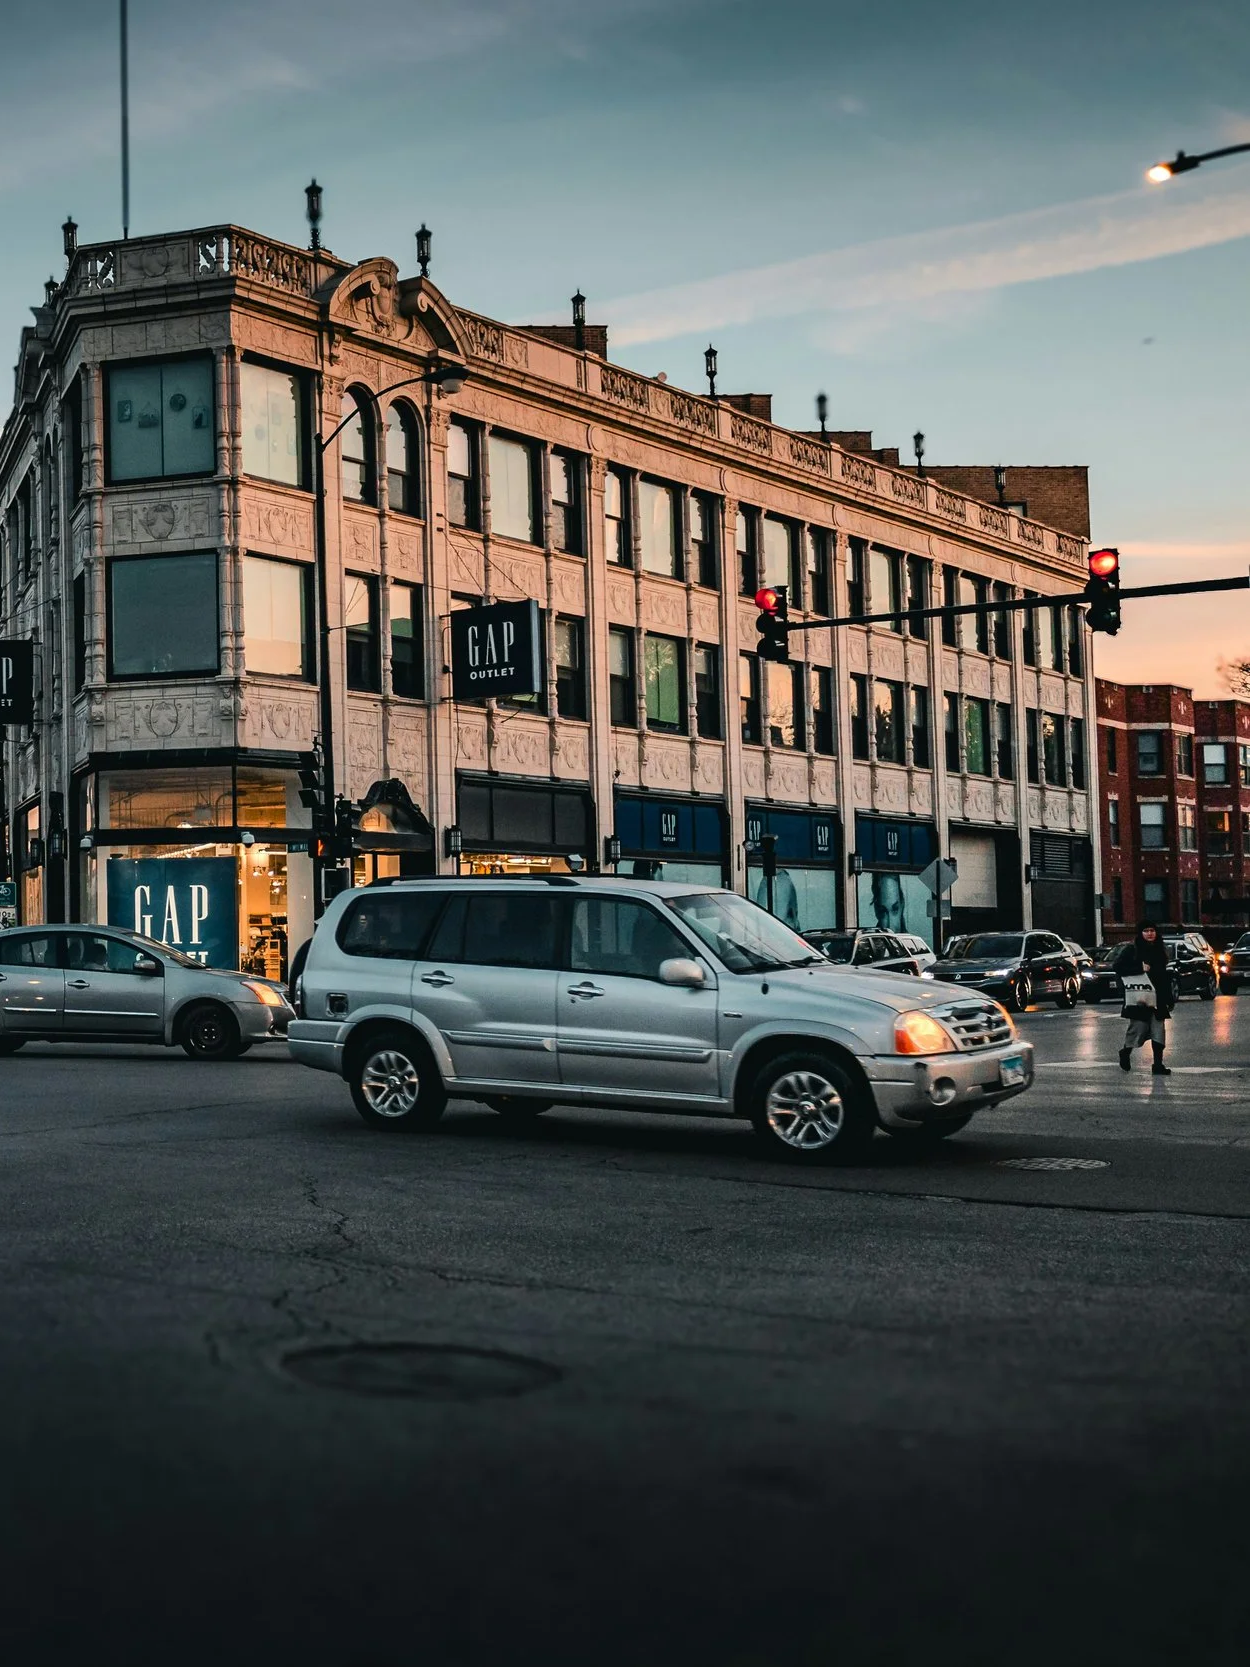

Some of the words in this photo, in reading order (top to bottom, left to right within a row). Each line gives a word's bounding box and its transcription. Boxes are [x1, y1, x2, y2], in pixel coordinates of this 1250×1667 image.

[468, 621, 514, 667] GAP
[470, 667, 515, 680] OUTLET
[662, 813, 676, 836] GAP
[748, 820, 761, 841] GAP
[817, 826, 829, 846] GAP
[887, 831, 898, 851] GAP
[134, 885, 209, 944] GAP
